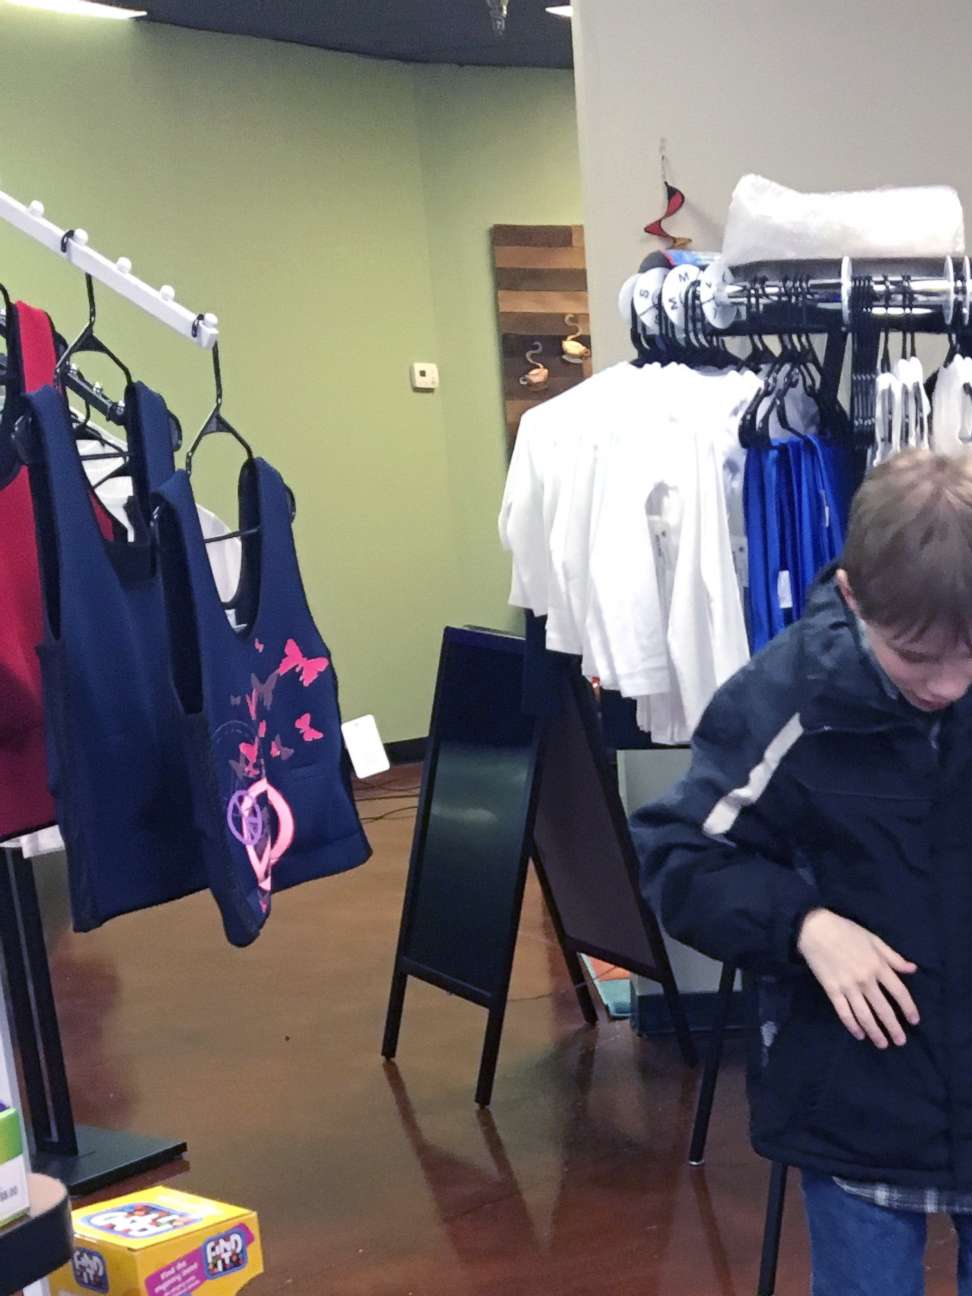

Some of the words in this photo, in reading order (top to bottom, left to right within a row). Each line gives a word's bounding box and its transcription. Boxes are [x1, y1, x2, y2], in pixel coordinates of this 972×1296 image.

[206, 1234, 242, 1263] FIND
[73, 1250, 104, 1276] FIND
[217, 1252, 232, 1272] IT
